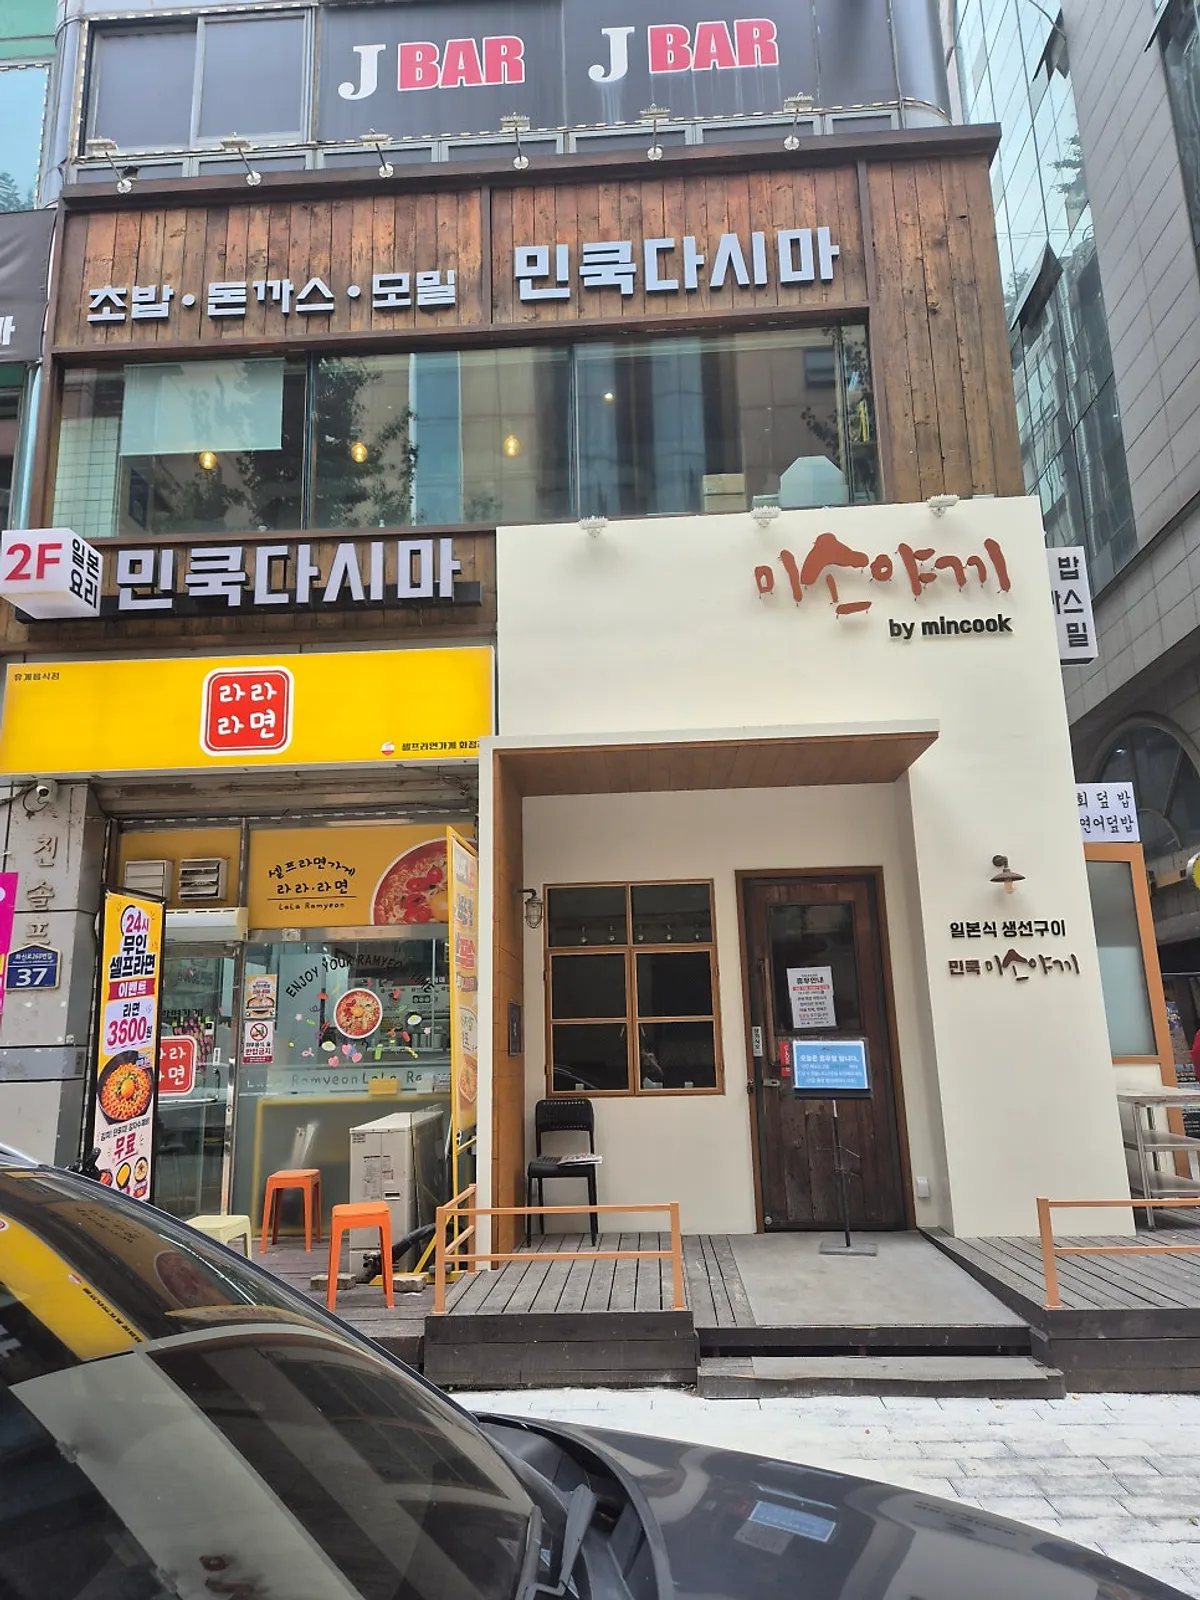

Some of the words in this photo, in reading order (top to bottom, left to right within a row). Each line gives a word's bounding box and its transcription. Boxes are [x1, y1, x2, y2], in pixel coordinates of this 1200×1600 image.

[588, 25, 635, 83] J
[648, 17, 779, 74] BAR
[338, 44, 386, 100] J
[397, 36, 525, 92] BAR
[514, 226, 840, 302] 민쿡다시마
[5, 543, 63, 580] 2F
[117, 538, 462, 612] 민쿡다시마
[888, 618, 916, 640] by
[921, 613, 1014, 637] mincook
[216, 711, 278, 740] 라면
[459, 740, 480, 750] 화정
[268, 856, 356, 879] 셀프라면가게
[304, 901, 345, 910] Ramyeon
[950, 921, 998, 938] 일본식
[1002, 919, 1067, 938] 생선구이
[122, 934, 148, 955] 무인
[16, 967, 48, 987] 37
[109, 953, 156, 979] 셀프라면
[285, 966, 320, 998] ENJOY
[321, 955, 354, 972] YOUR
[948, 959, 981, 976] 민쿡
[118, 981, 147, 998] 이벤트
[122, 1001, 141, 1018] 라면
[114, 1131, 137, 1159] 무료
